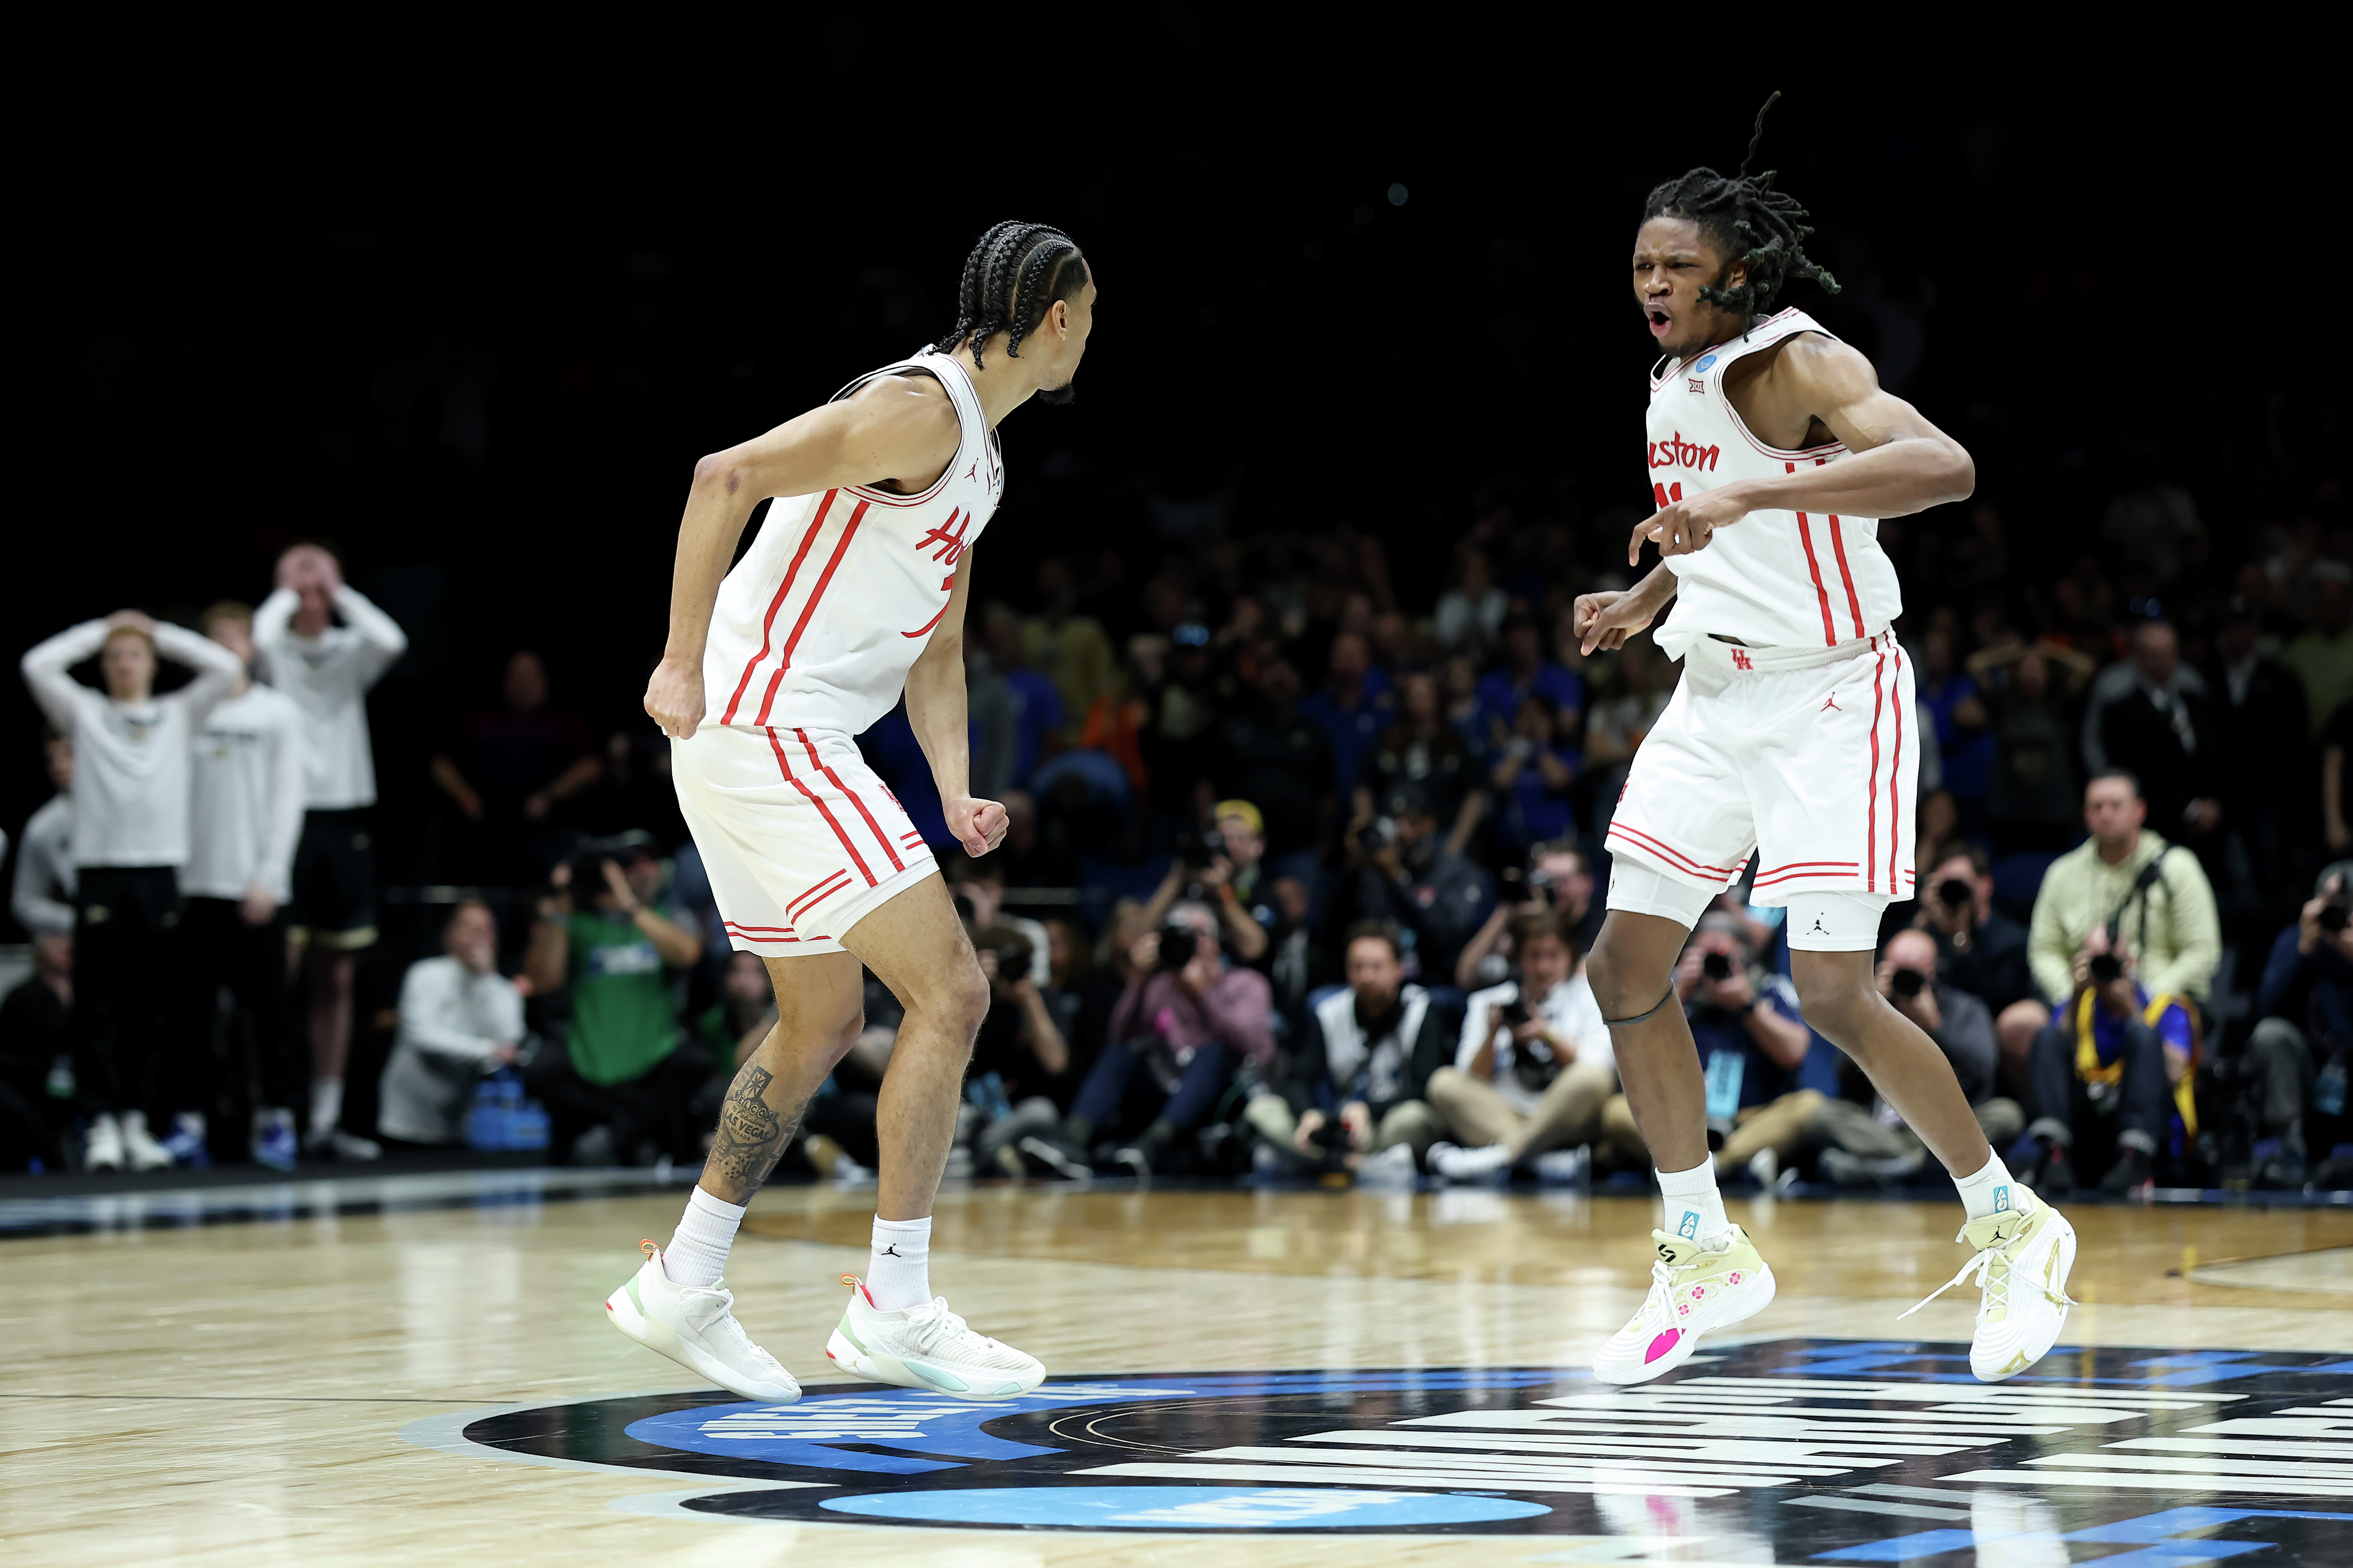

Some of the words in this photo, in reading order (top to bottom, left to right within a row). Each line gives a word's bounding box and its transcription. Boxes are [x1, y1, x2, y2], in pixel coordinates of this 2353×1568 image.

[915, 505, 970, 566] Ho
[725, 1108, 738, 1126] LAS
[739, 1121, 769, 1139] VEGAS
[733, 1090, 779, 1122] WELCOME
[732, 1127, 750, 1140] NEVADA
[697, 1398, 1020, 1439] SWEET
[1063, 1376, 2251, 1497] MARCH
[1105, 1490, 1440, 1526] NCAA
